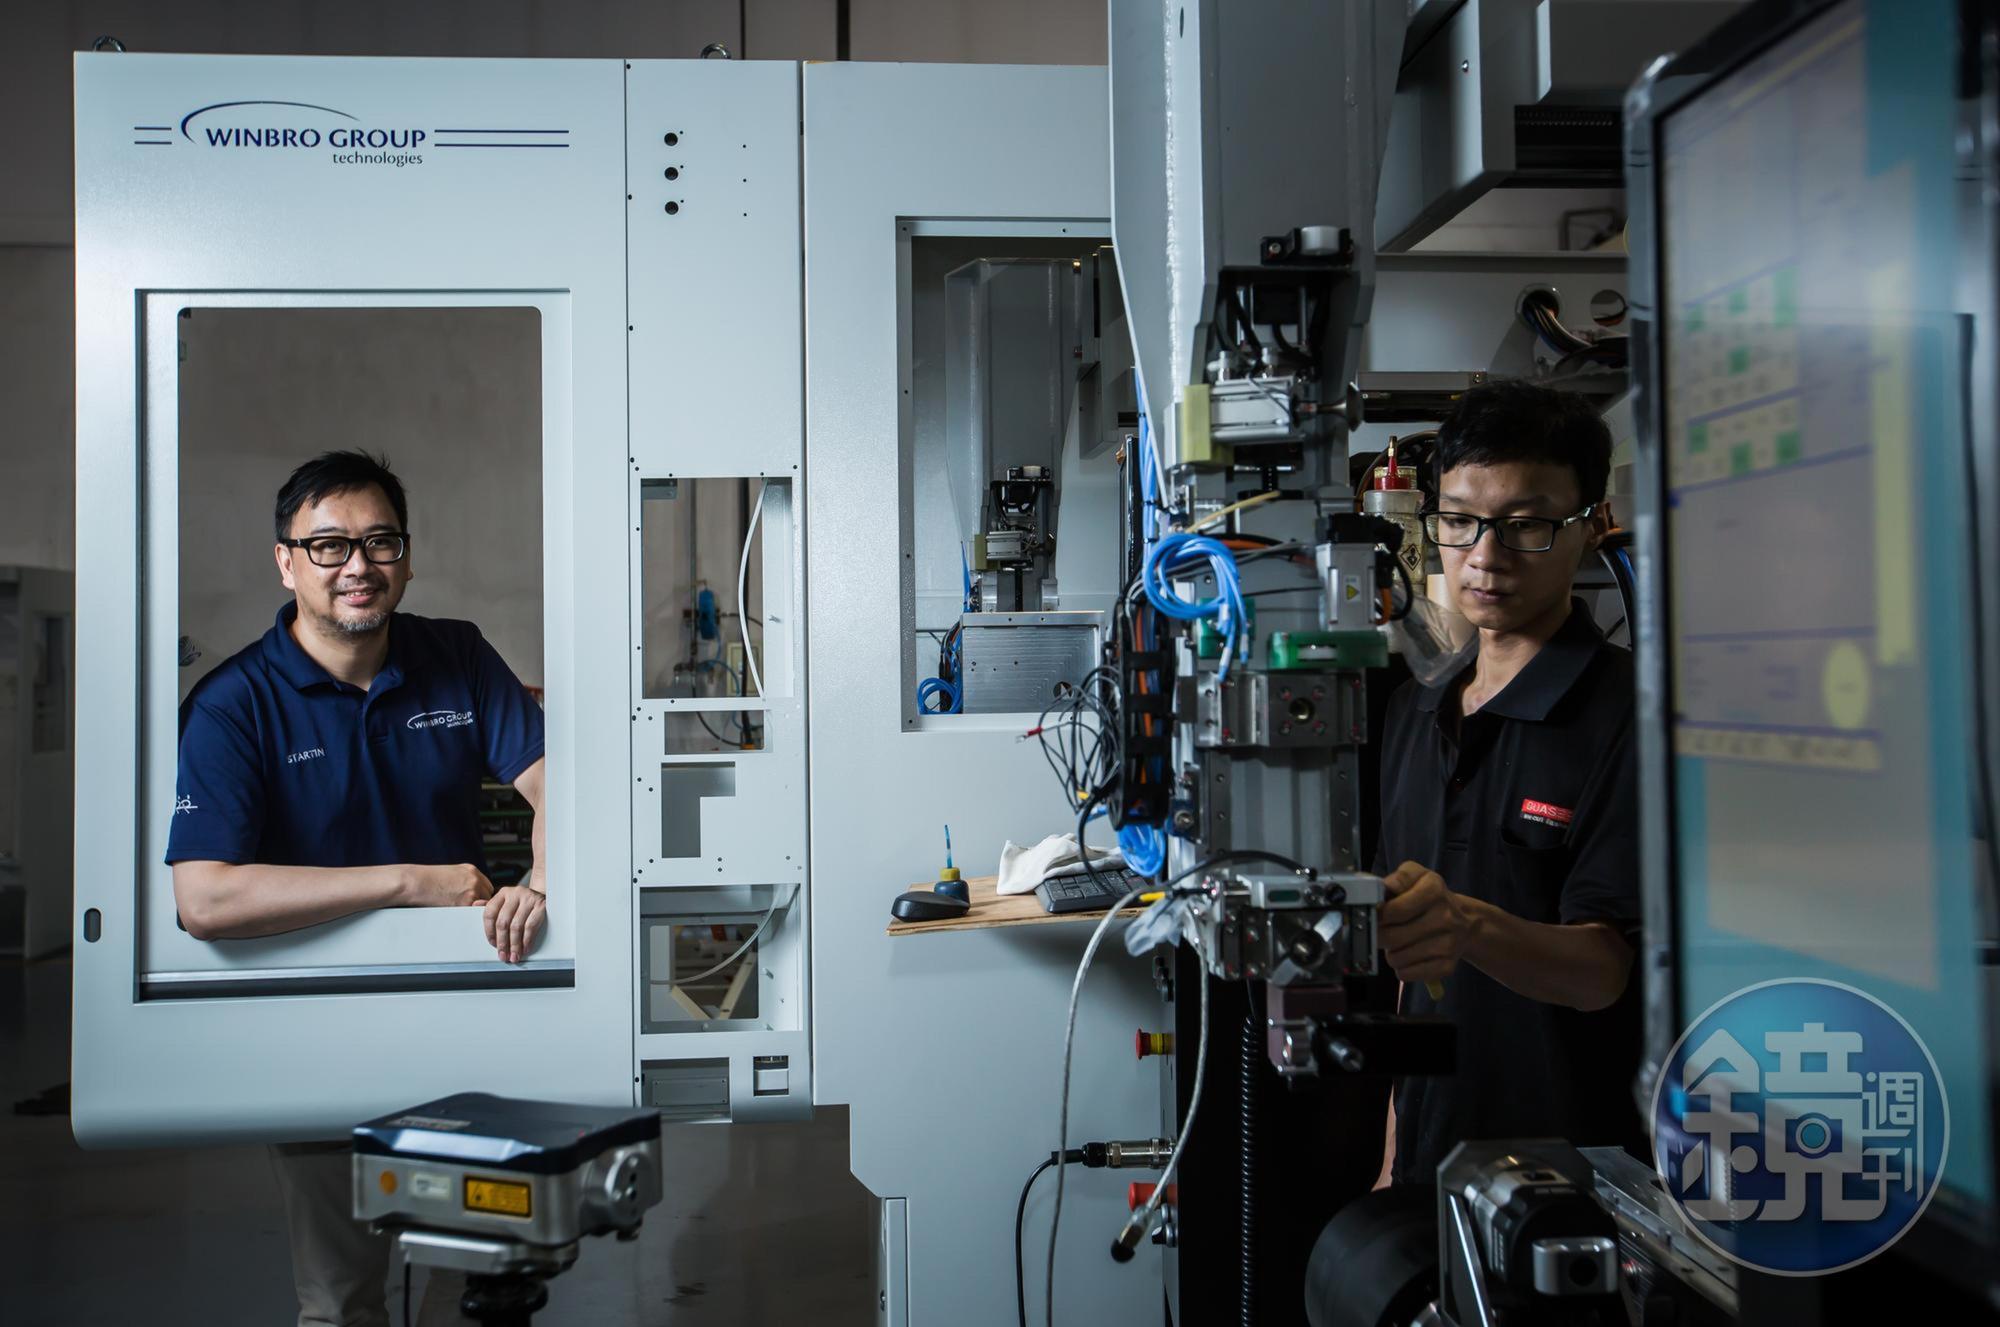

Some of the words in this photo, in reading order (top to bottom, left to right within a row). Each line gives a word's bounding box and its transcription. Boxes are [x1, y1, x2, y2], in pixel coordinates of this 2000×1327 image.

[206, 128, 321, 148] WINBRO
[328, 128, 426, 148] GROUP
[333, 151, 423, 167] technologies
[287, 747, 326, 764] STARTIN
